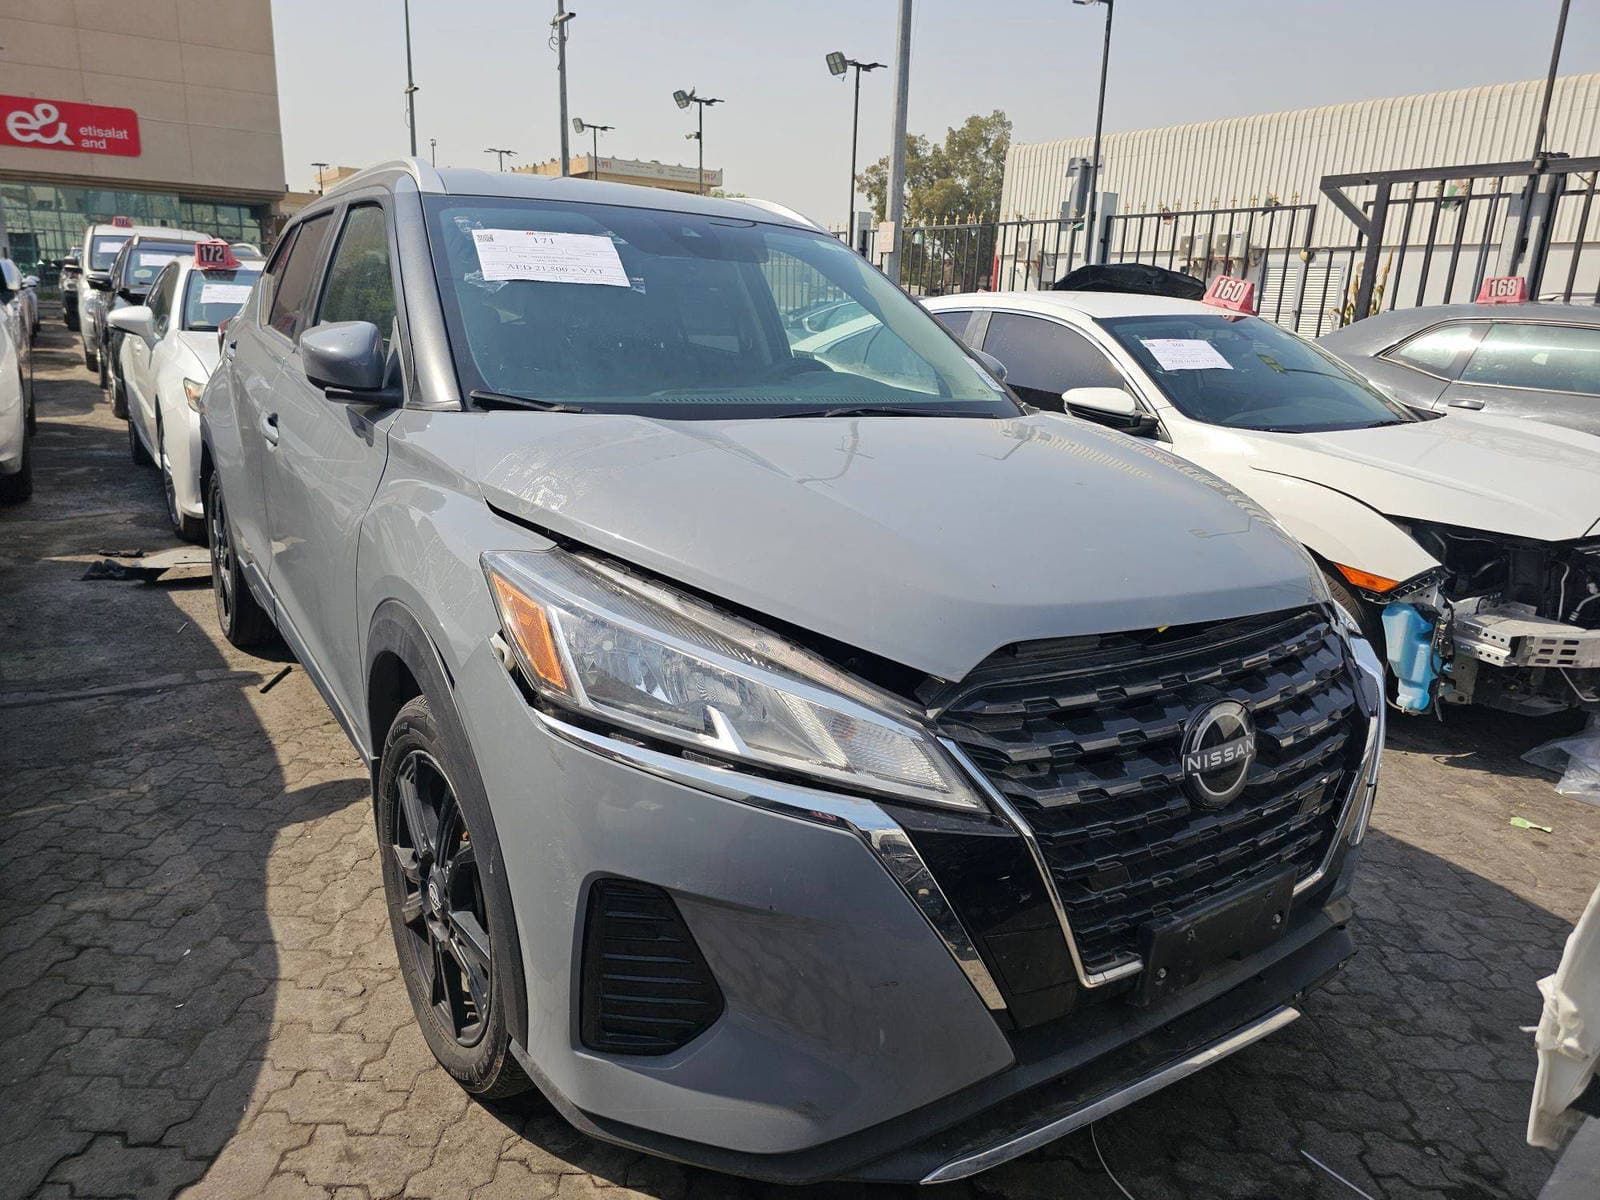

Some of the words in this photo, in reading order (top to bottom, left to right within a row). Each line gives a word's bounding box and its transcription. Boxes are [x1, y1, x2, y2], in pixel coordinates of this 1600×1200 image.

[79, 125, 128, 140] etisalat
[81, 138, 107, 150] and
[533, 237, 554, 245] 171
[201, 245, 224, 262] 172
[1214, 279, 1245, 302] 160
[1490, 279, 1517, 297] 168
[1187, 736, 1254, 771] NISSAN
